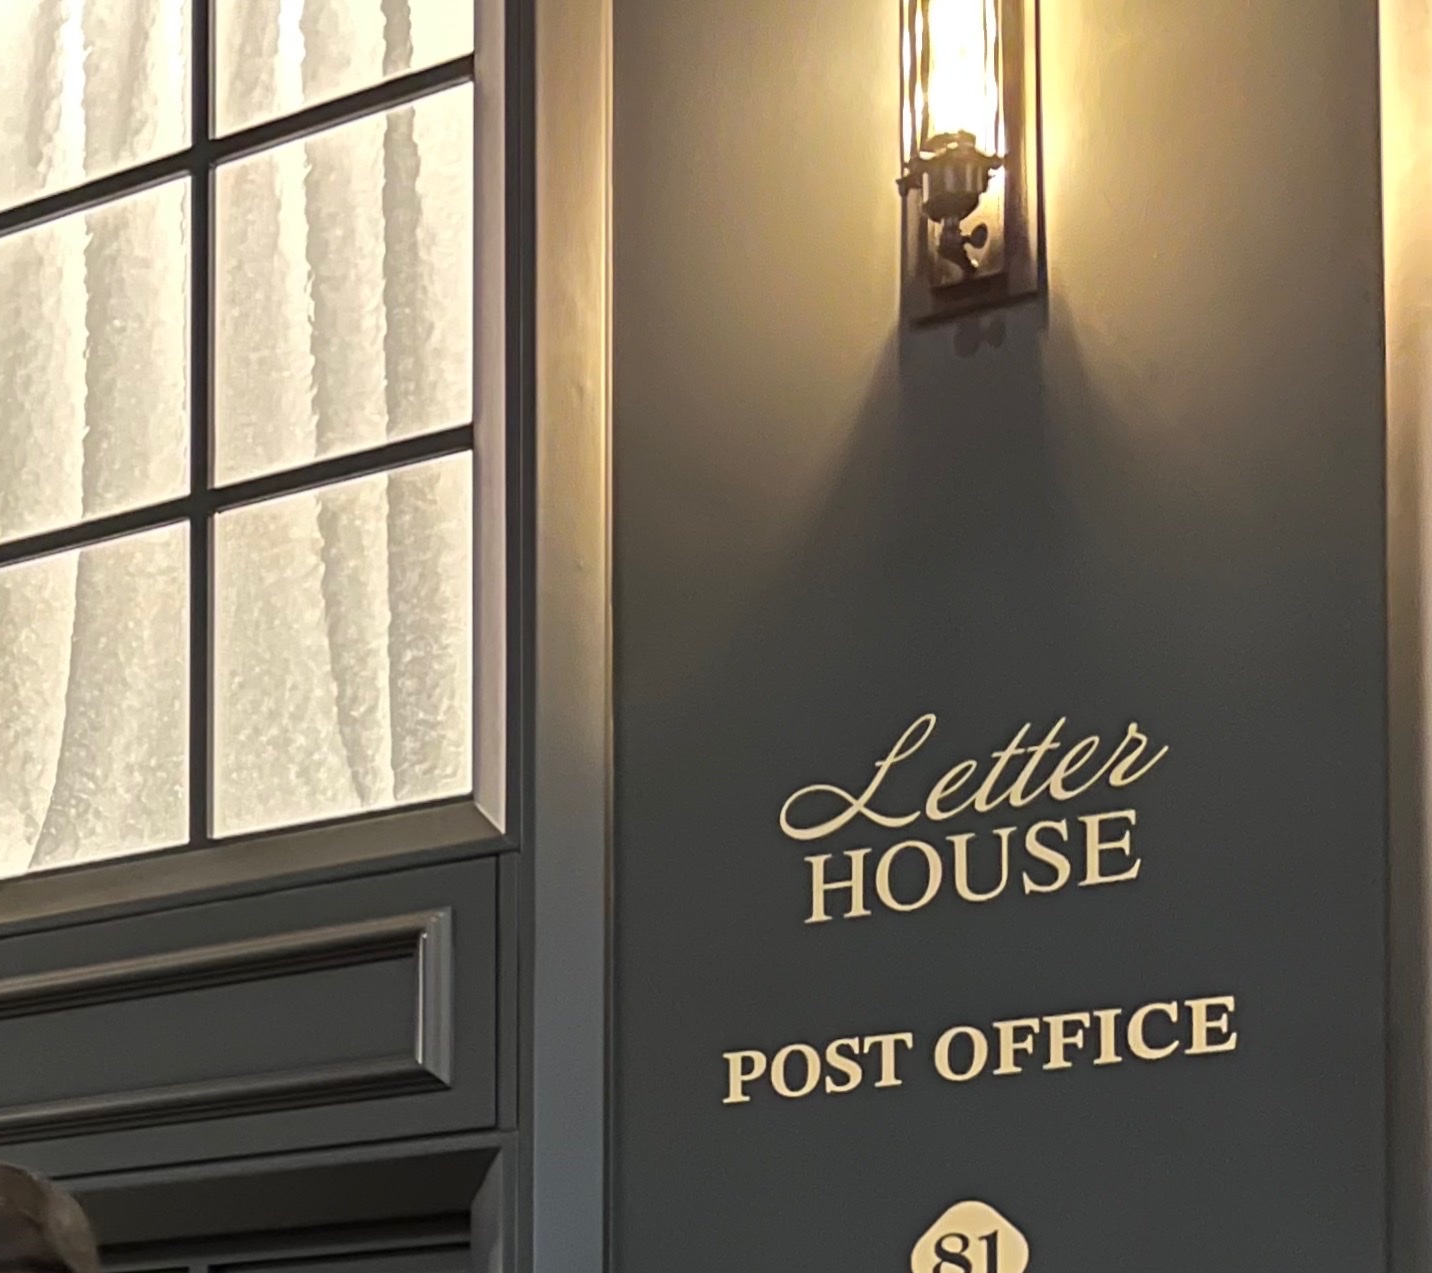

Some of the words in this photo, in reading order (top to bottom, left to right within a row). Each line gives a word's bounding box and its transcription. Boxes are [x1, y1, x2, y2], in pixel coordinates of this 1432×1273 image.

[779, 713, 1169, 840] Letter
[804, 809, 1142, 924] HOUSE
[722, 1032, 914, 1104] POST
[934, 995, 1238, 1082] OFFICE
